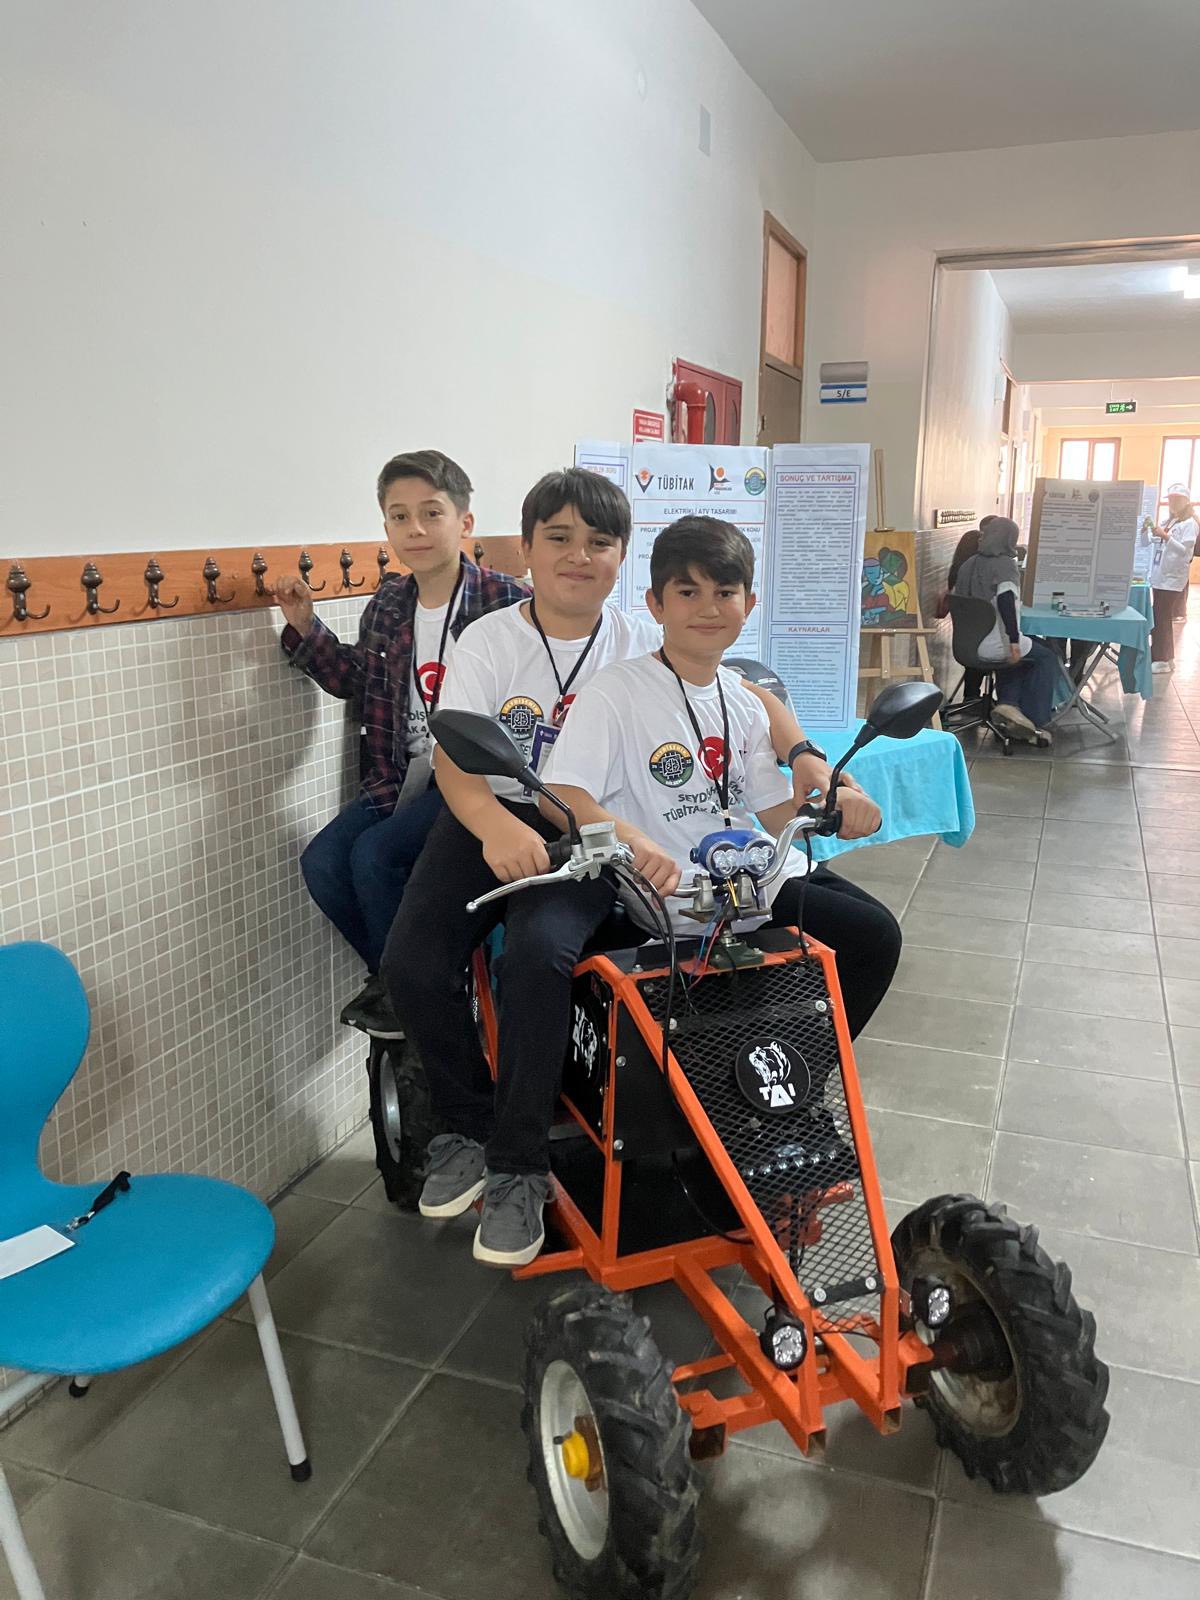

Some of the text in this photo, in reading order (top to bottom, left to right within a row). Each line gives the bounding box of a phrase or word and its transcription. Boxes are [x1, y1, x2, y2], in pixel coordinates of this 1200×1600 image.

[836, 388, 851, 399] S/E
[658, 474, 695, 491] TÜBİTAK
[759, 1082, 796, 1108] TAI
